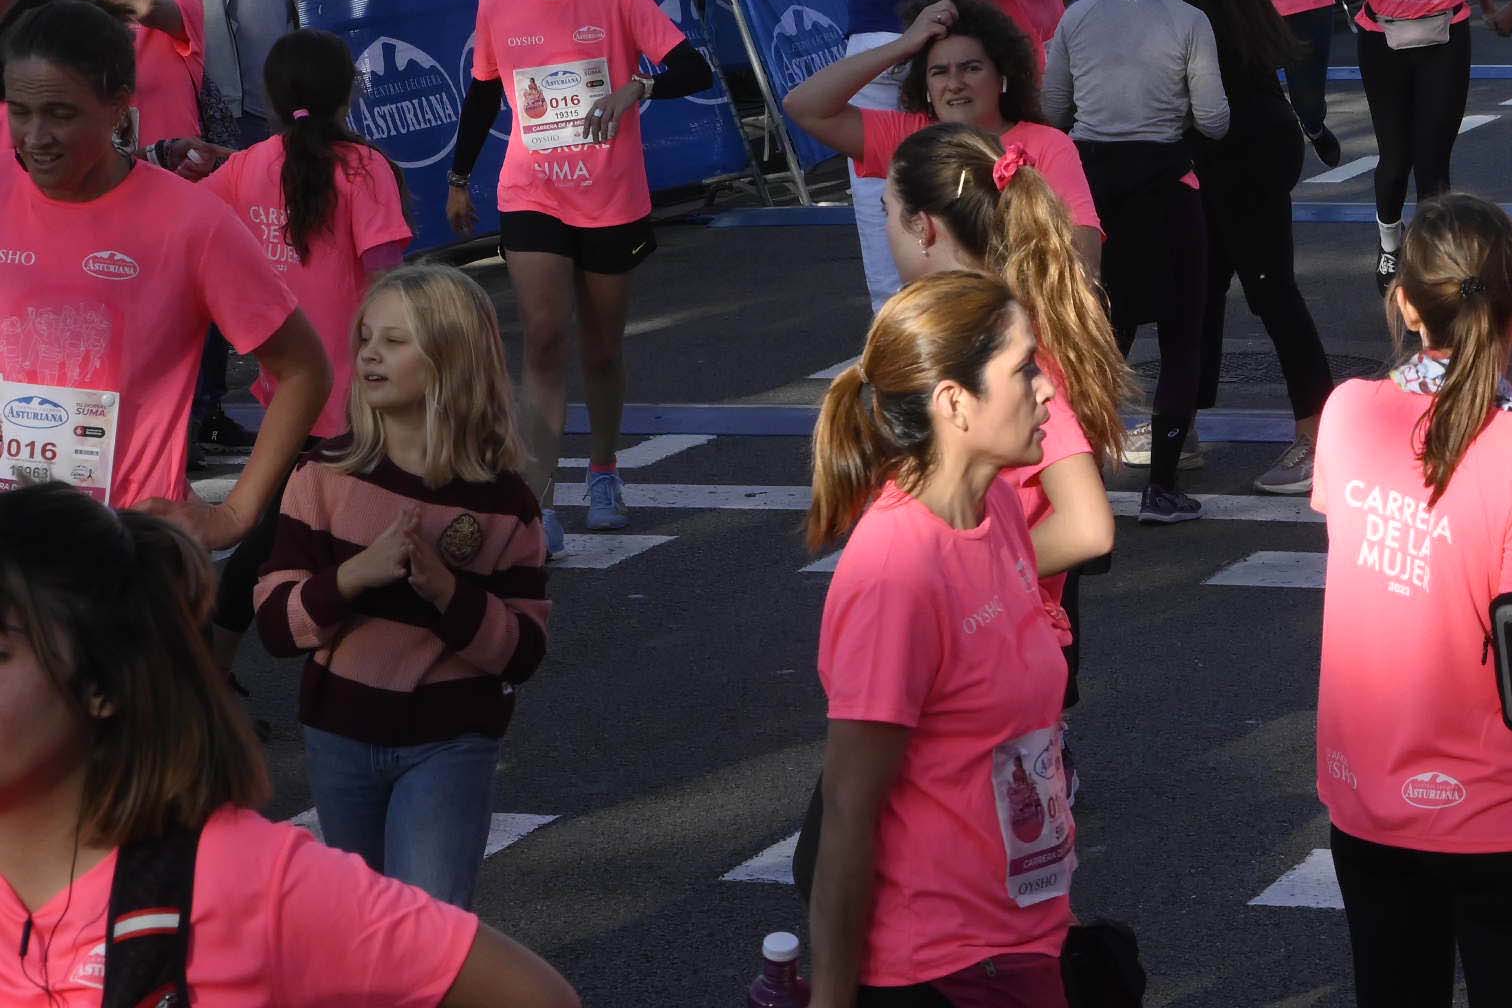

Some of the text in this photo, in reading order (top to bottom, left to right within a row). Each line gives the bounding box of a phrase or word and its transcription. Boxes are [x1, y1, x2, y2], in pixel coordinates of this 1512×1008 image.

[507, 35, 545, 47] OYSHO
[544, 77, 579, 88] ASTURIANA
[549, 94, 581, 110] 016
[359, 91, 458, 141] ASTURIANA
[554, 110, 579, 120] 19315
[86, 260, 135, 276] ASTURIANA
[7, 405, 106, 423] ASTURIANA SUMA
[7, 438, 57, 462] 016
[1343, 478, 1453, 545] CARREA
[1365, 513, 1433, 560] DE LA
[1405, 783, 1460, 801] ASTURIANA
[1017, 874, 1058, 896] OYSHO
